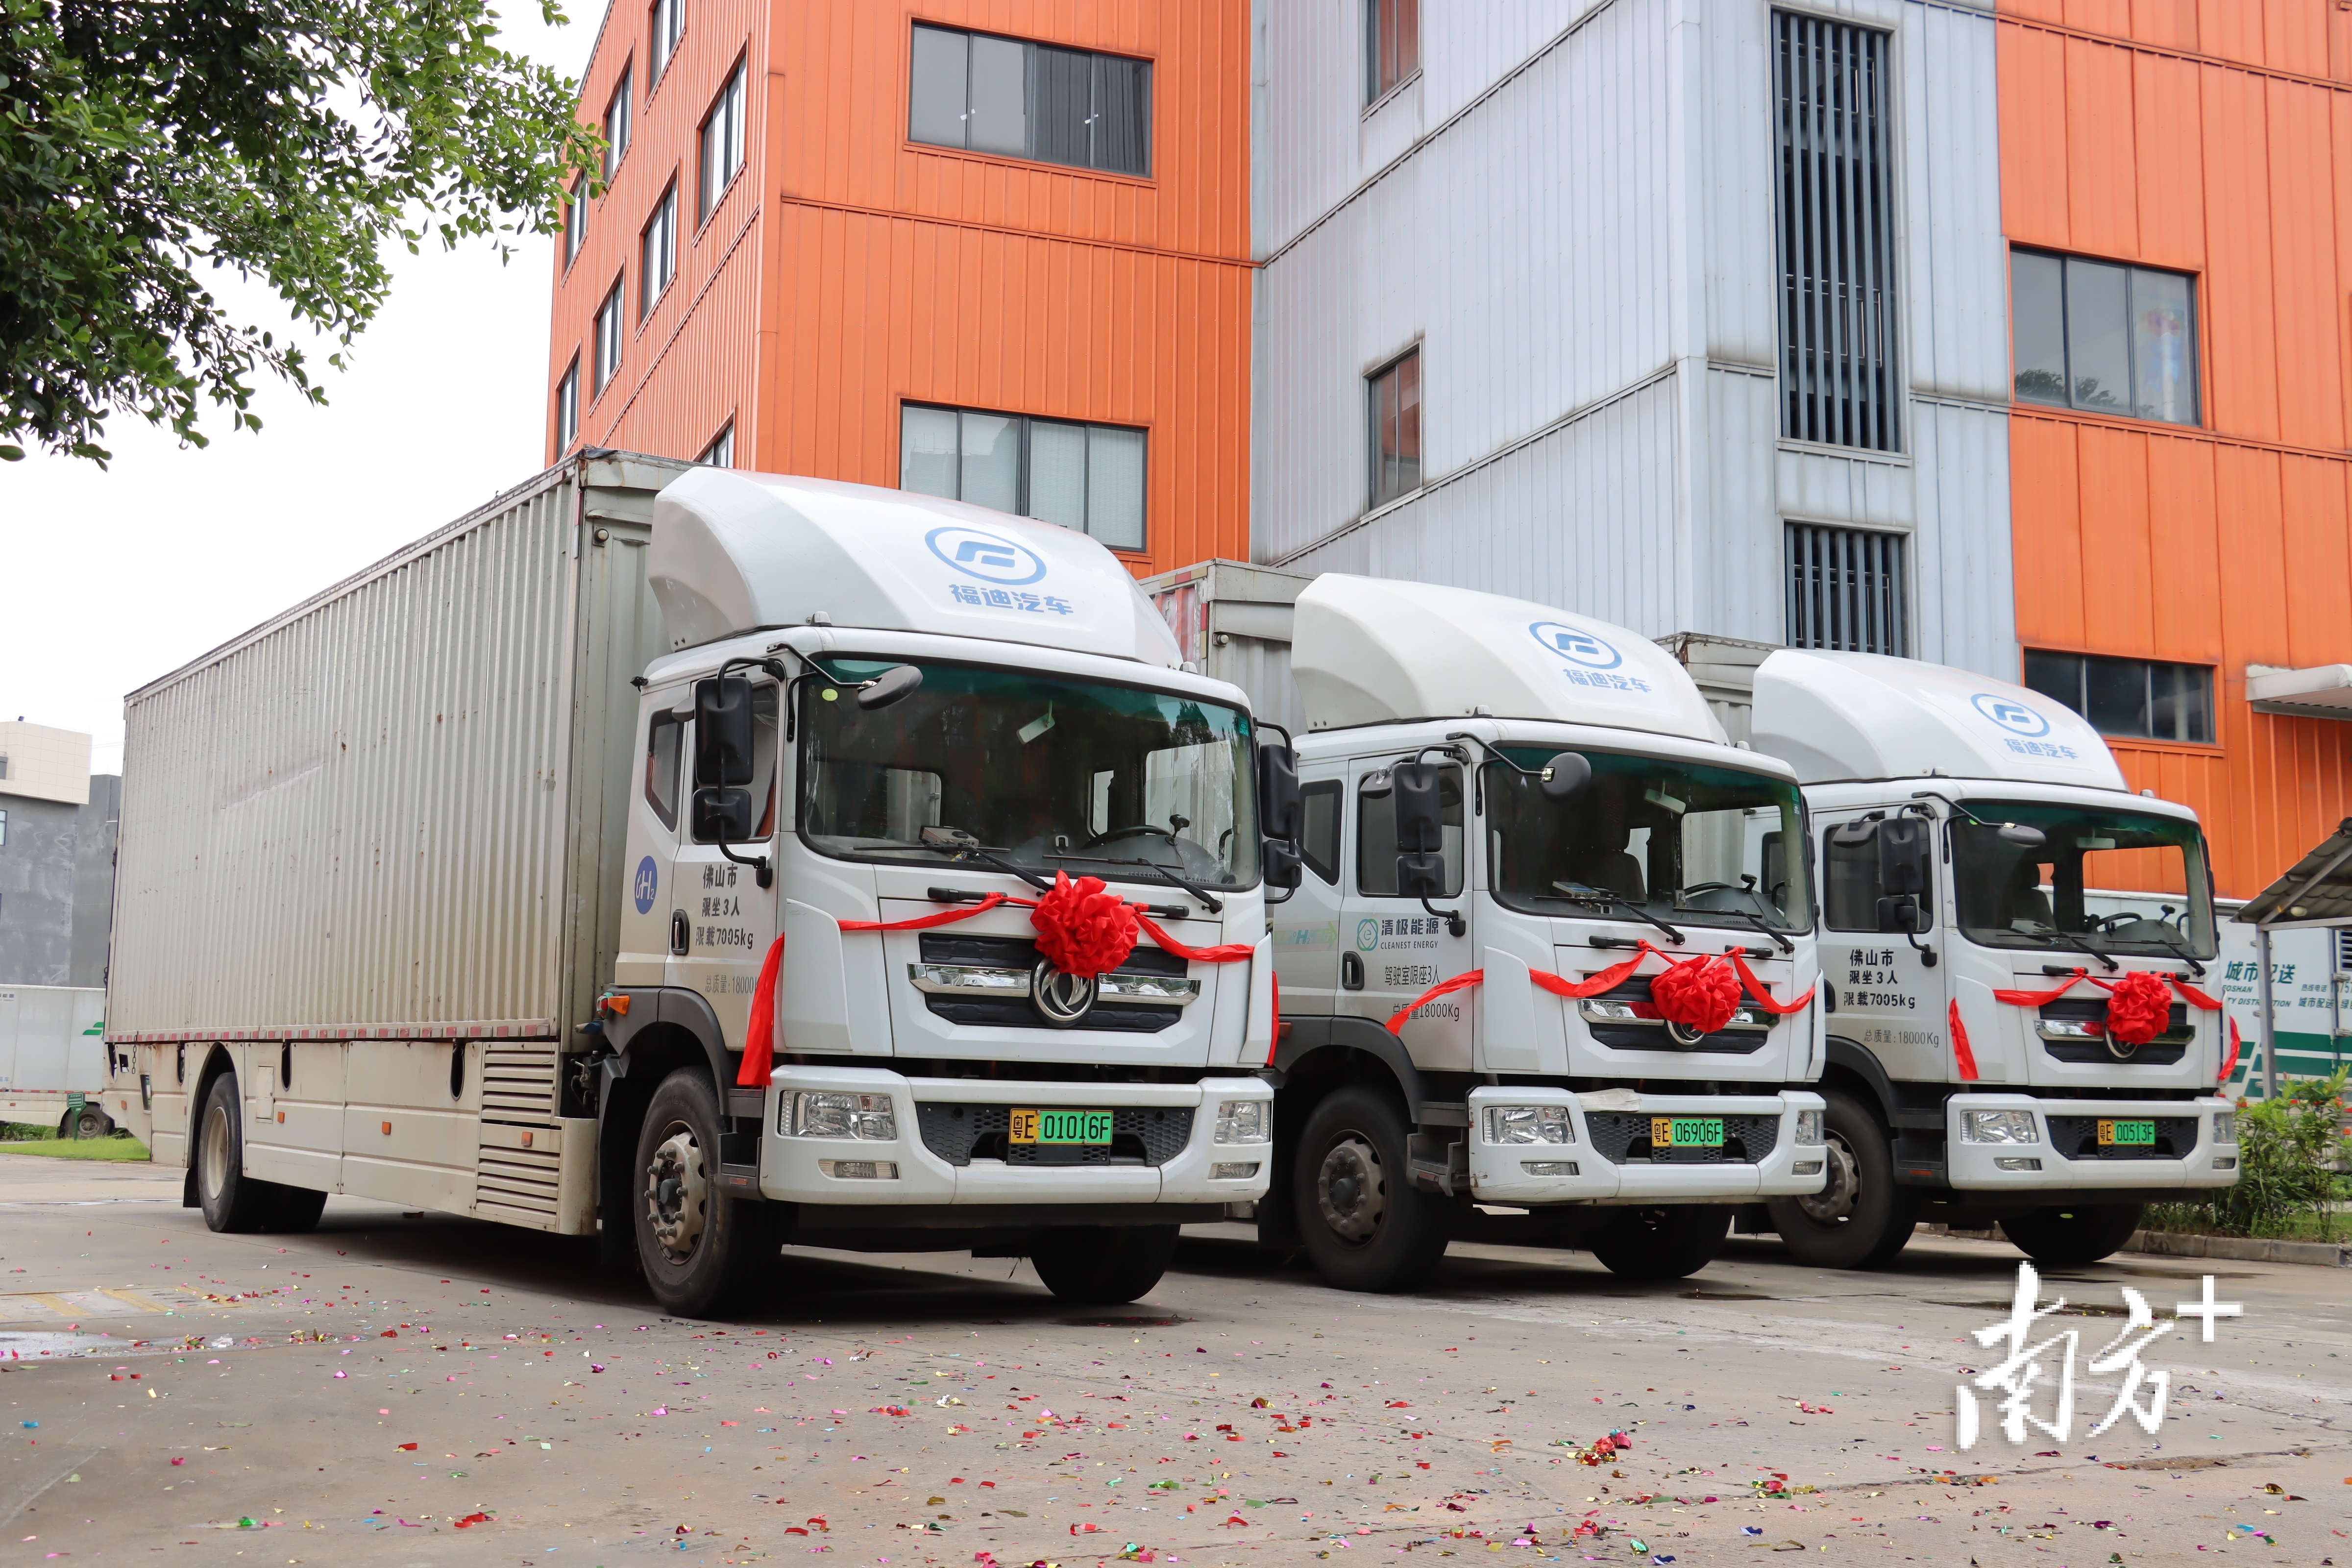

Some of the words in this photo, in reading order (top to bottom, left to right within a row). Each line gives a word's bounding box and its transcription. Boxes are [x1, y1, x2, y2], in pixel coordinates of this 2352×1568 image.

[949, 584, 1074, 615] 福迪汽车
[1563, 668, 1652, 692] 福迪汽车
[2004, 738, 2079, 760] 福迪汽车
[703, 863, 738, 889] 佛山市
[702, 896, 740, 917] 限坐3人
[1381, 918, 1439, 936] 清极能源
[695, 926, 754, 950] 限载7005kg
[1380, 941, 1411, 950] CLEANEST
[1413, 940, 1438, 949] ENERGY
[1850, 949, 1894, 967] 佛山市
[1385, 964, 1440, 986] 驾驶室限座3人
[1849, 970, 1898, 984] 限坐3人
[1844, 991, 1915, 1009] 限载7005kg
